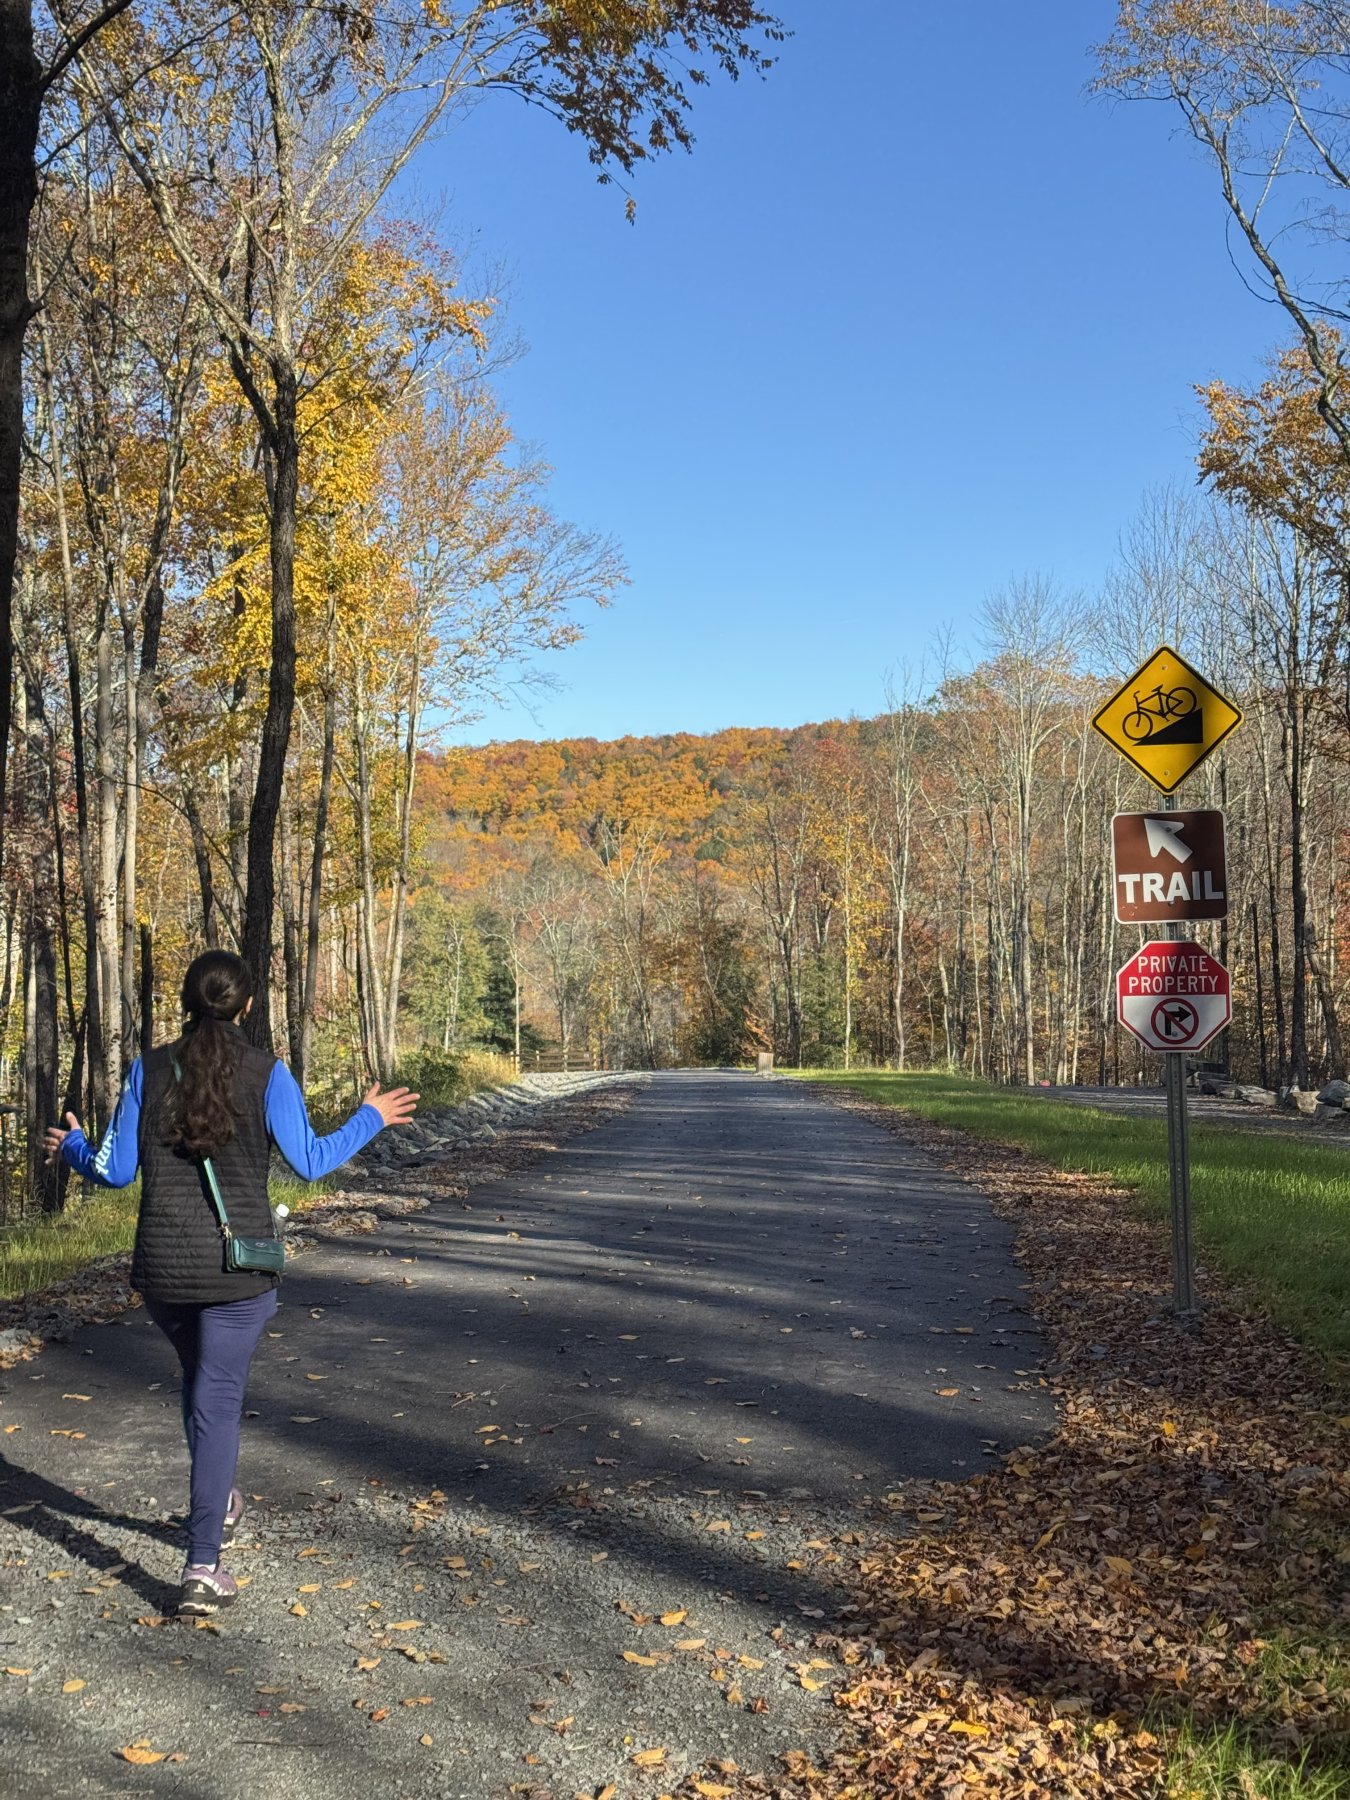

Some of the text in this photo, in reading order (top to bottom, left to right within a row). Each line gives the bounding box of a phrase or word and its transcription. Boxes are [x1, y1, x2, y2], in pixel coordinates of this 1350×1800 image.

[1118, 870, 1224, 904] TRAIL
[1137, 955, 1209, 973] PRIVATE
[1128, 975, 1219, 994] PROPERTY
